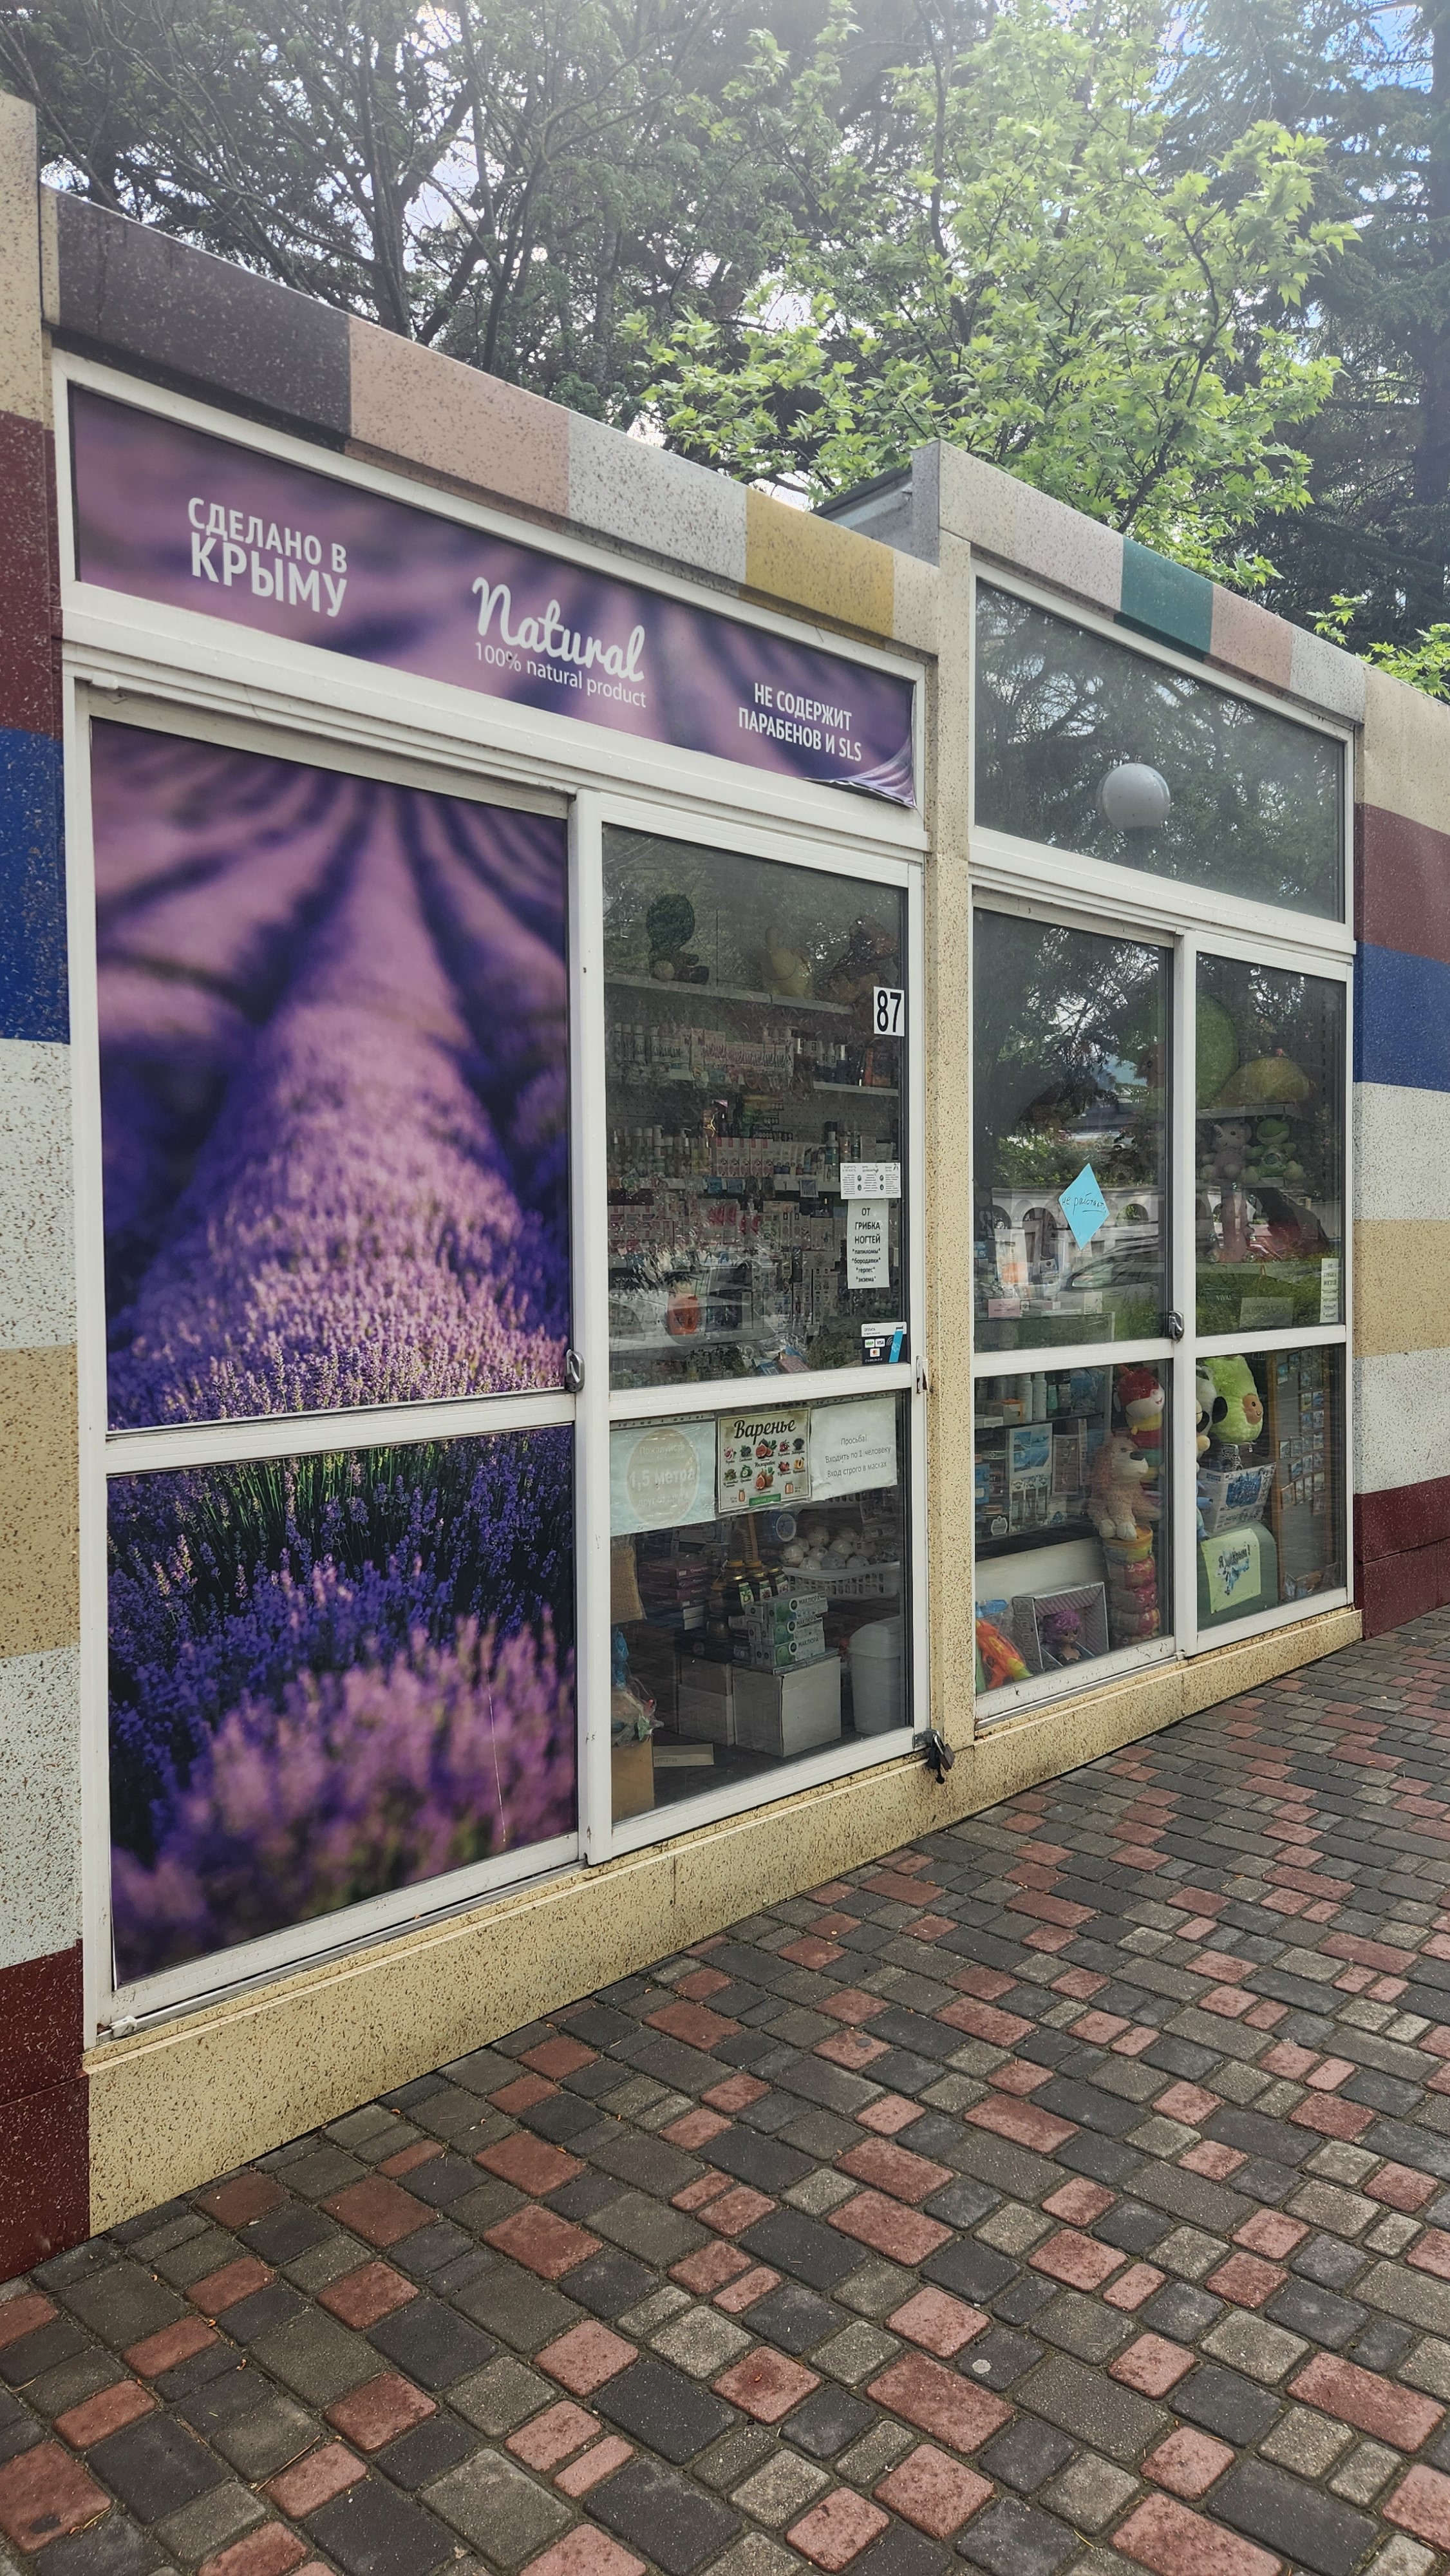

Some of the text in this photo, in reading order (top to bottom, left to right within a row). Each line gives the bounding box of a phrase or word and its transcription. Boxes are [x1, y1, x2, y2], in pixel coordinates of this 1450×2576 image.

[188, 497, 348, 573] СДЕЛАНО В
[191, 531, 348, 618] КРЫМУ
[472, 576, 646, 683] Natural
[475, 641, 646, 708] 100% natural product
[755, 682, 852, 732] НЕ СОДЕРЖИТ
[739, 706, 862, 762] ПАРАБЕНОВ И SLS
[876, 989, 902, 1033] 87
[862, 1208, 871, 1216] ОТ
[1062, 1197, 1071, 1206] не
[854, 1222, 881, 1230] ГРИБКА
[854, 1233, 881, 1244] НОГТЕЙ
[733, 1419, 796, 1446] Варенье
[841, 1434, 867, 1446] Просьба!
[825, 1454, 850, 1463] Входить
[864, 1446, 891, 1455] человеку
[629, 1467, 696, 1492] 1,5 метра
[827, 1470, 842, 1478] Вход
[843, 1466, 862, 1475] строго
[867, 1461, 887, 1470] масках
[798, 1595, 821, 1605] МАКЛЮРА
[798, 1636, 819, 1647] МАКЛЮРА
